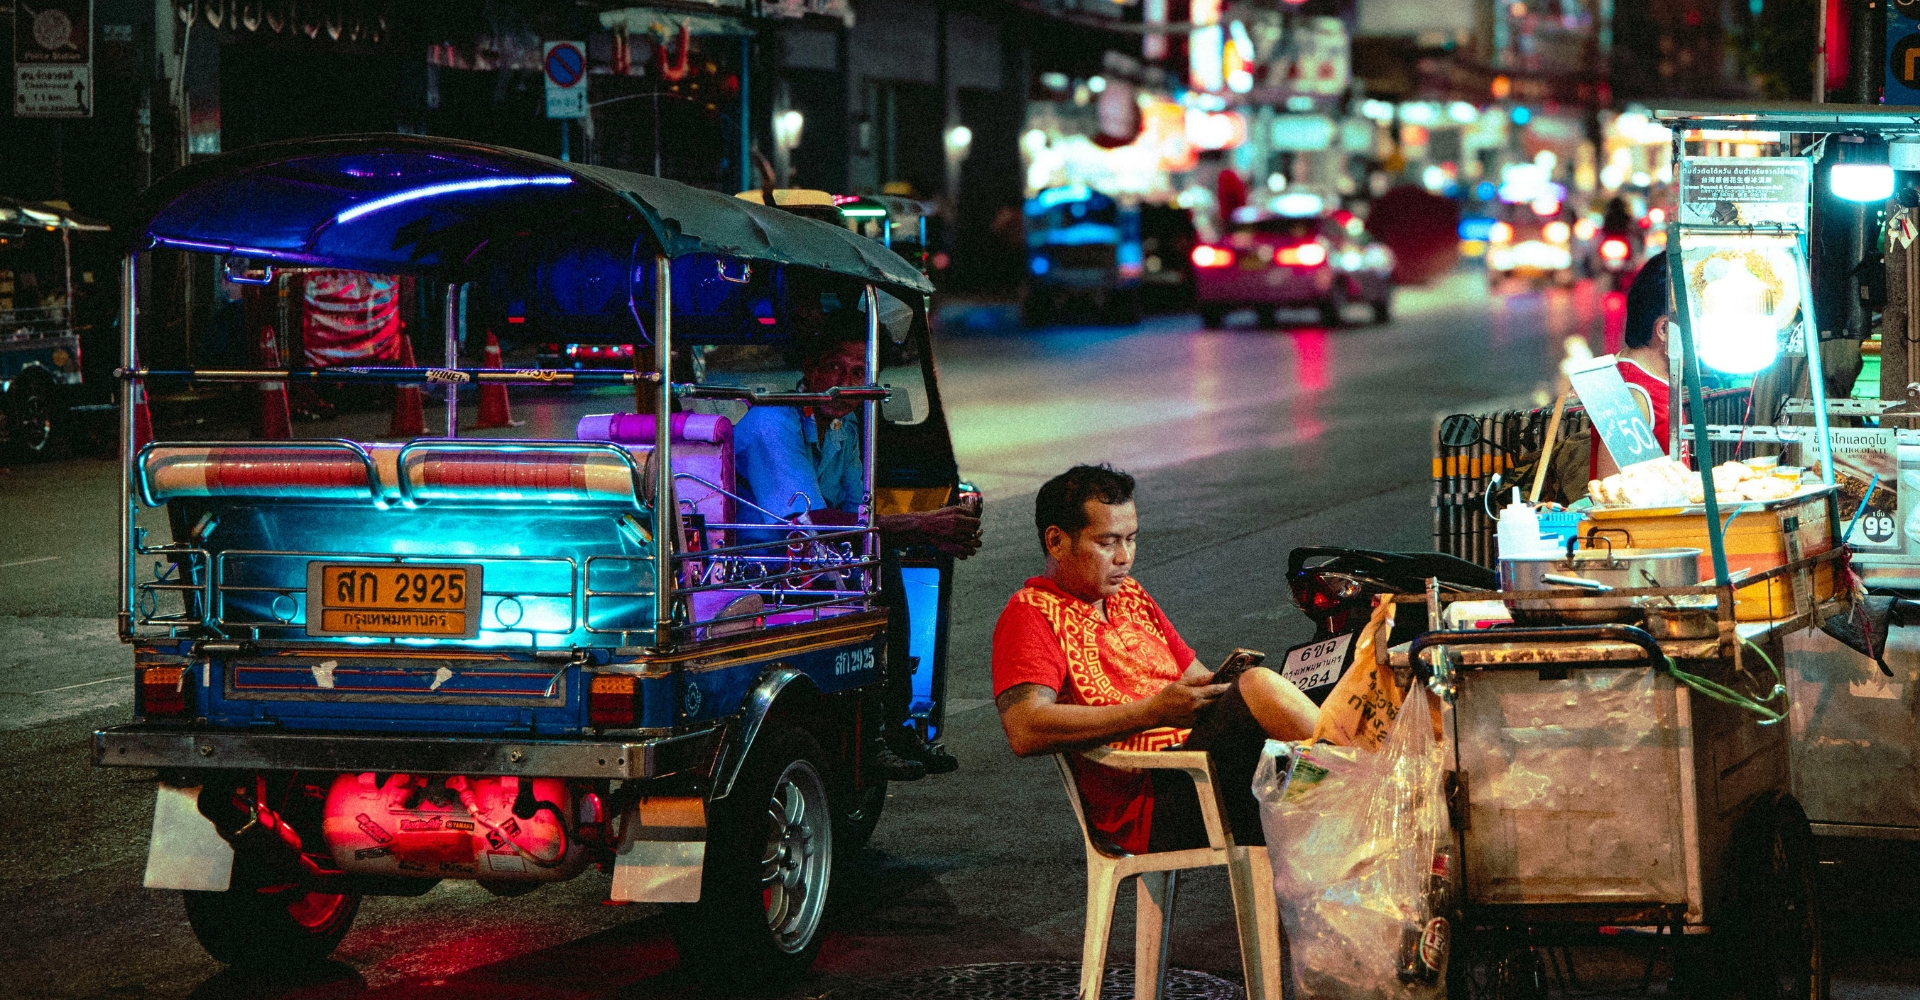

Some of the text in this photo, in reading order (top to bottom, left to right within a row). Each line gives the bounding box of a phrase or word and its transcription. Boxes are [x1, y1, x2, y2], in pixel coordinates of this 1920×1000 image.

[1617, 416, 1653, 455] 50
[1865, 517, 1893, 536] 99
[337, 570, 464, 603] สก 2925
[343, 613, 447, 630] กรุงเทพมหานคร
[1283, 655, 1342, 681] กรุงเทพมหานคร
[1292, 669, 1330, 691] 284
[453, 821, 474, 830] YAMAHA
